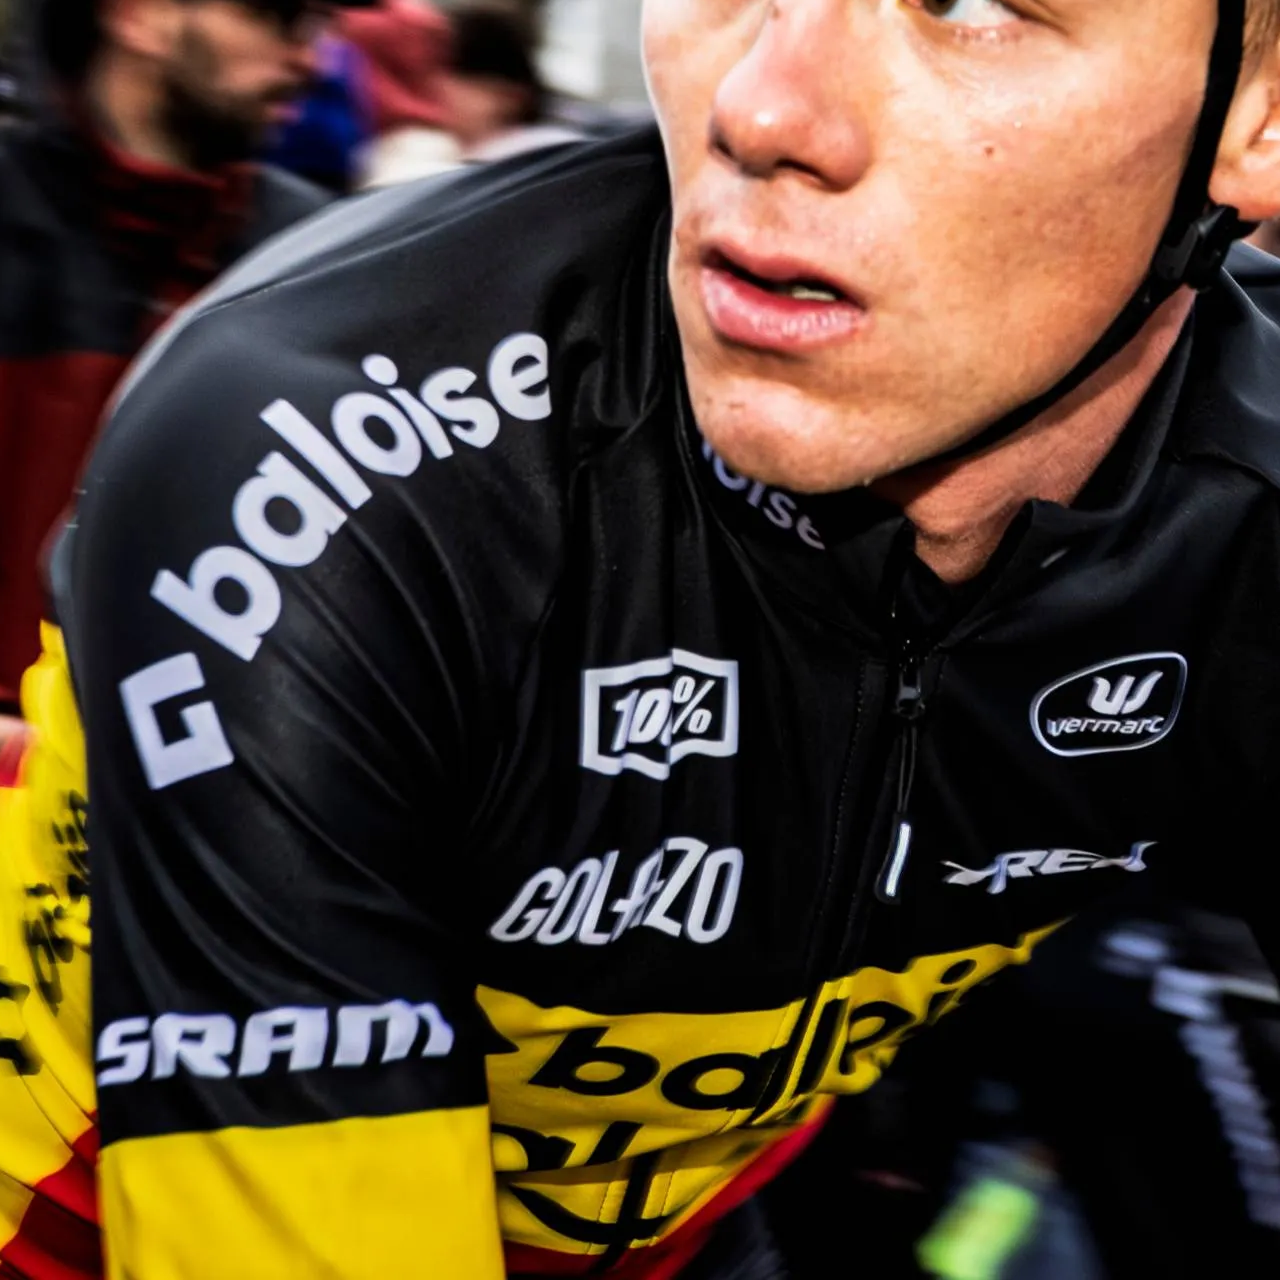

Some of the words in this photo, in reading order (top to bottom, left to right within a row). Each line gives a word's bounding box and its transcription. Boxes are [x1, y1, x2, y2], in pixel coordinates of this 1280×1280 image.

[150, 332, 553, 661] baloise
[700, 438, 826, 551] oise
[1047, 716, 1165, 738] vermarc
[97, 1000, 454, 1087] SRAM
